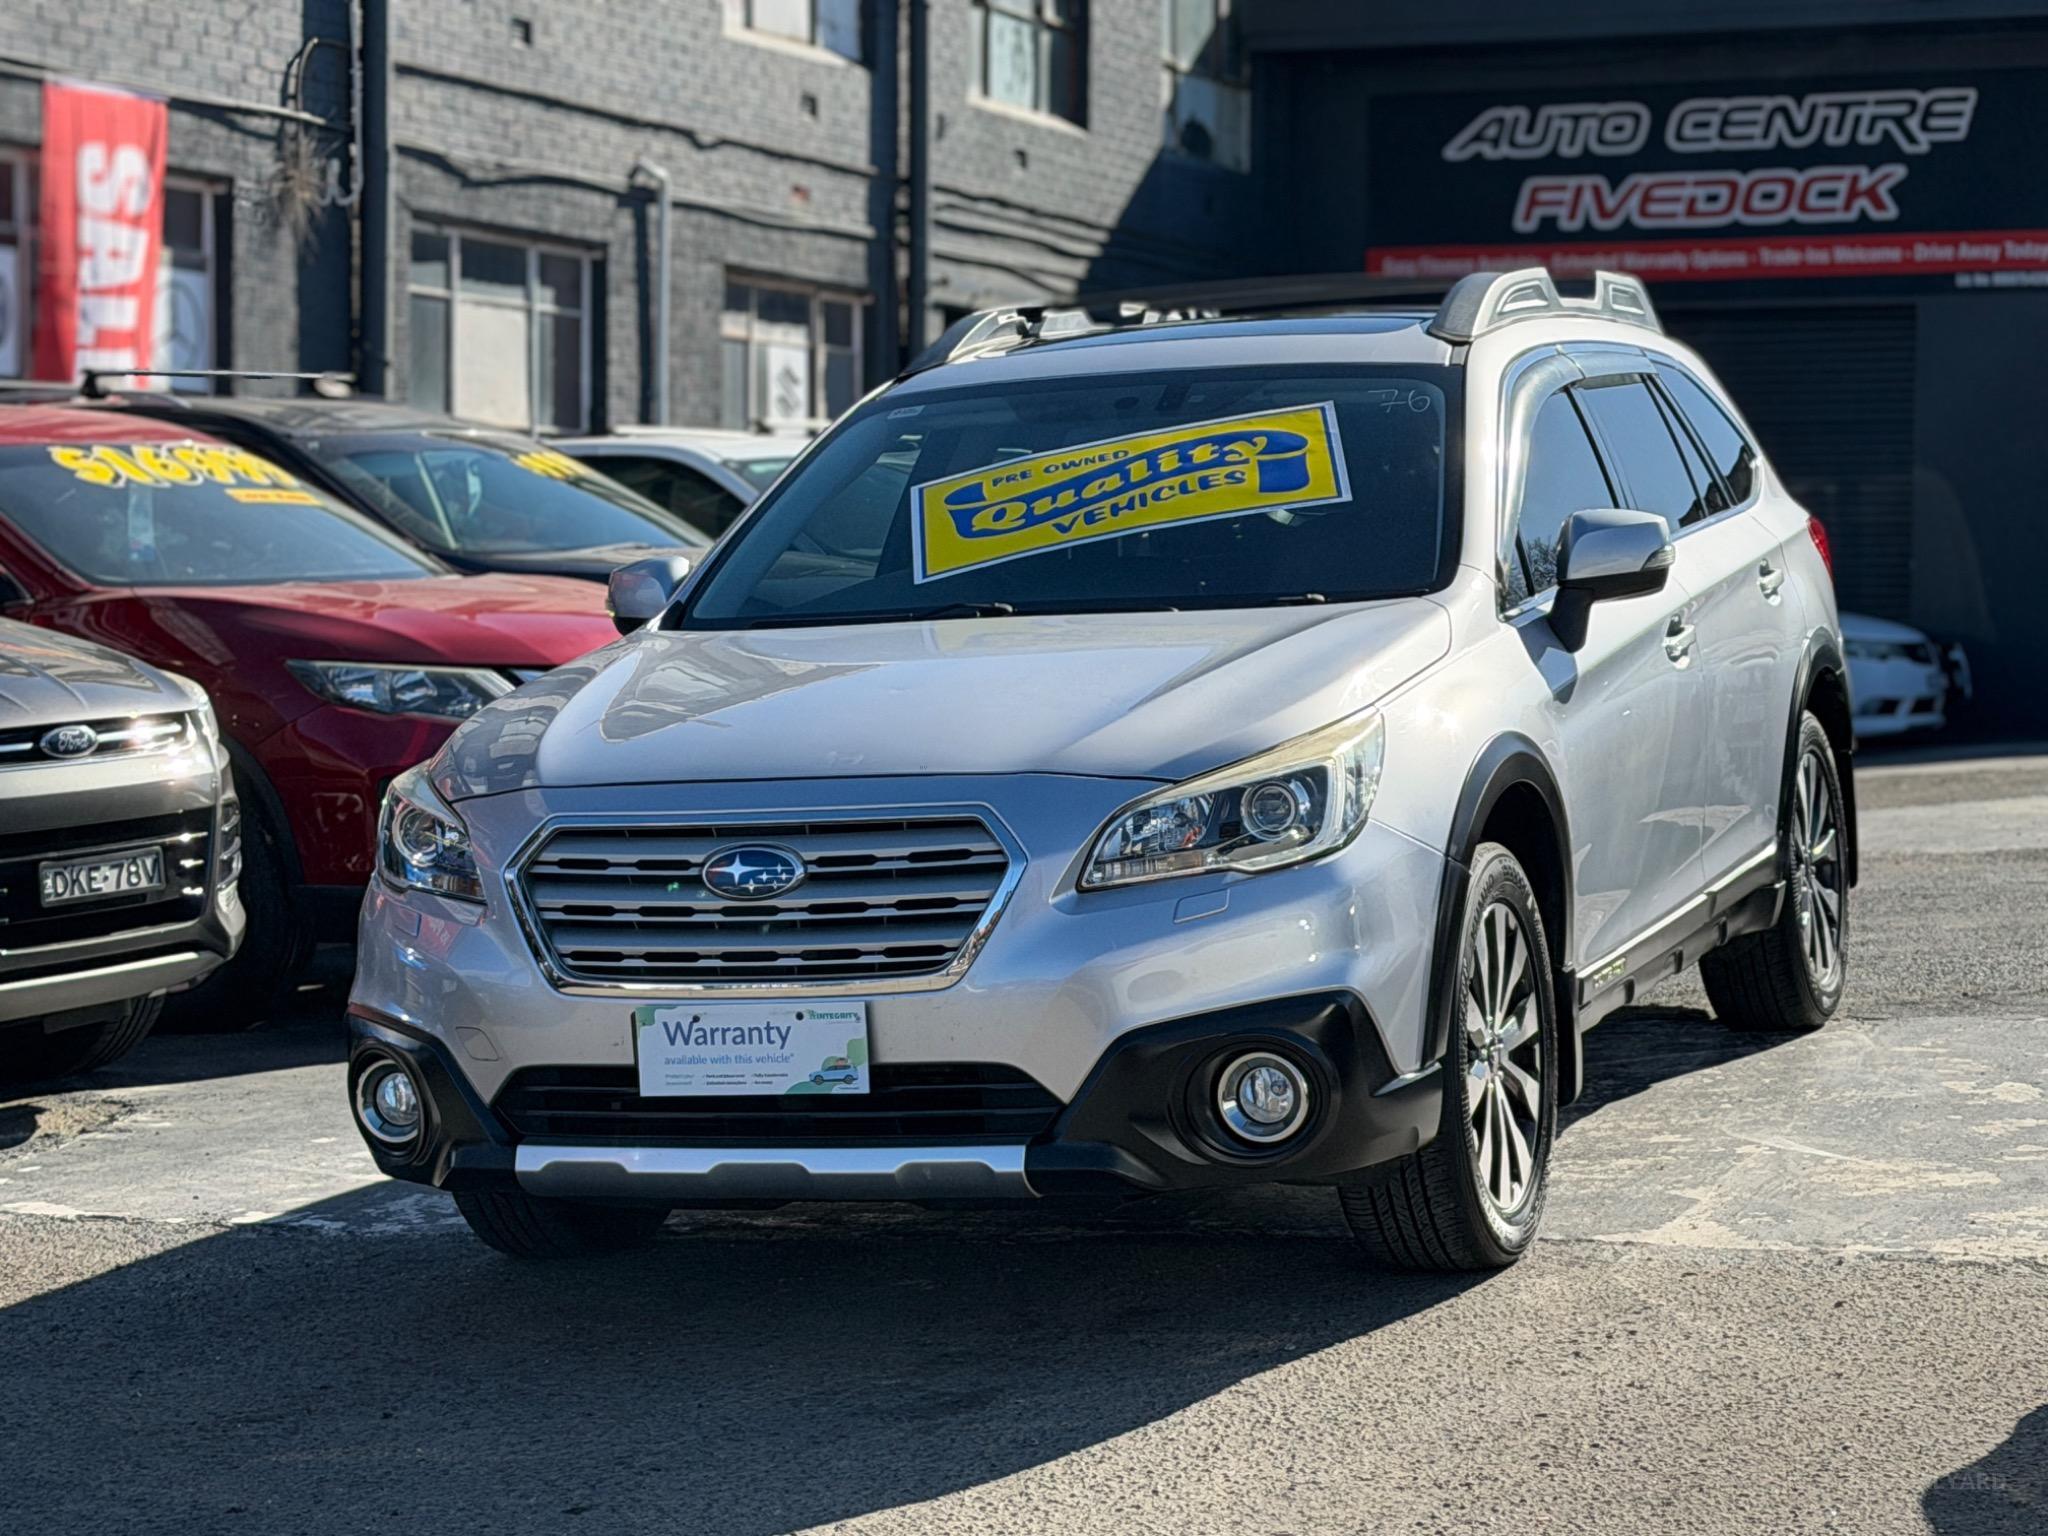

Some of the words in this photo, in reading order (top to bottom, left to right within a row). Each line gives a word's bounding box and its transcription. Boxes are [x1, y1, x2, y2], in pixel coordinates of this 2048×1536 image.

[1441, 102, 1651, 161] AUTO
[1664, 87, 1977, 153] CENTRE
[1512, 163, 1908, 233] FIVEDOCK
[1623, 251, 1687, 272] Warranty
[1834, 244, 1902, 263] Welcome
[1914, 242, 1955, 261] Drive
[1958, 241, 1999, 262] Away
[971, 436, 1268, 532] Quality
[991, 469, 1033, 487] PRE
[1043, 450, 1130, 475] OWNED
[1051, 470, 1248, 535] VEHICLES
[58, 729, 91, 752] Ford
[662, 1020, 791, 1050] Warranty
[664, 1054, 708, 1066] available
[710, 1054, 732, 1065] with
[734, 1053, 753, 1064] this
